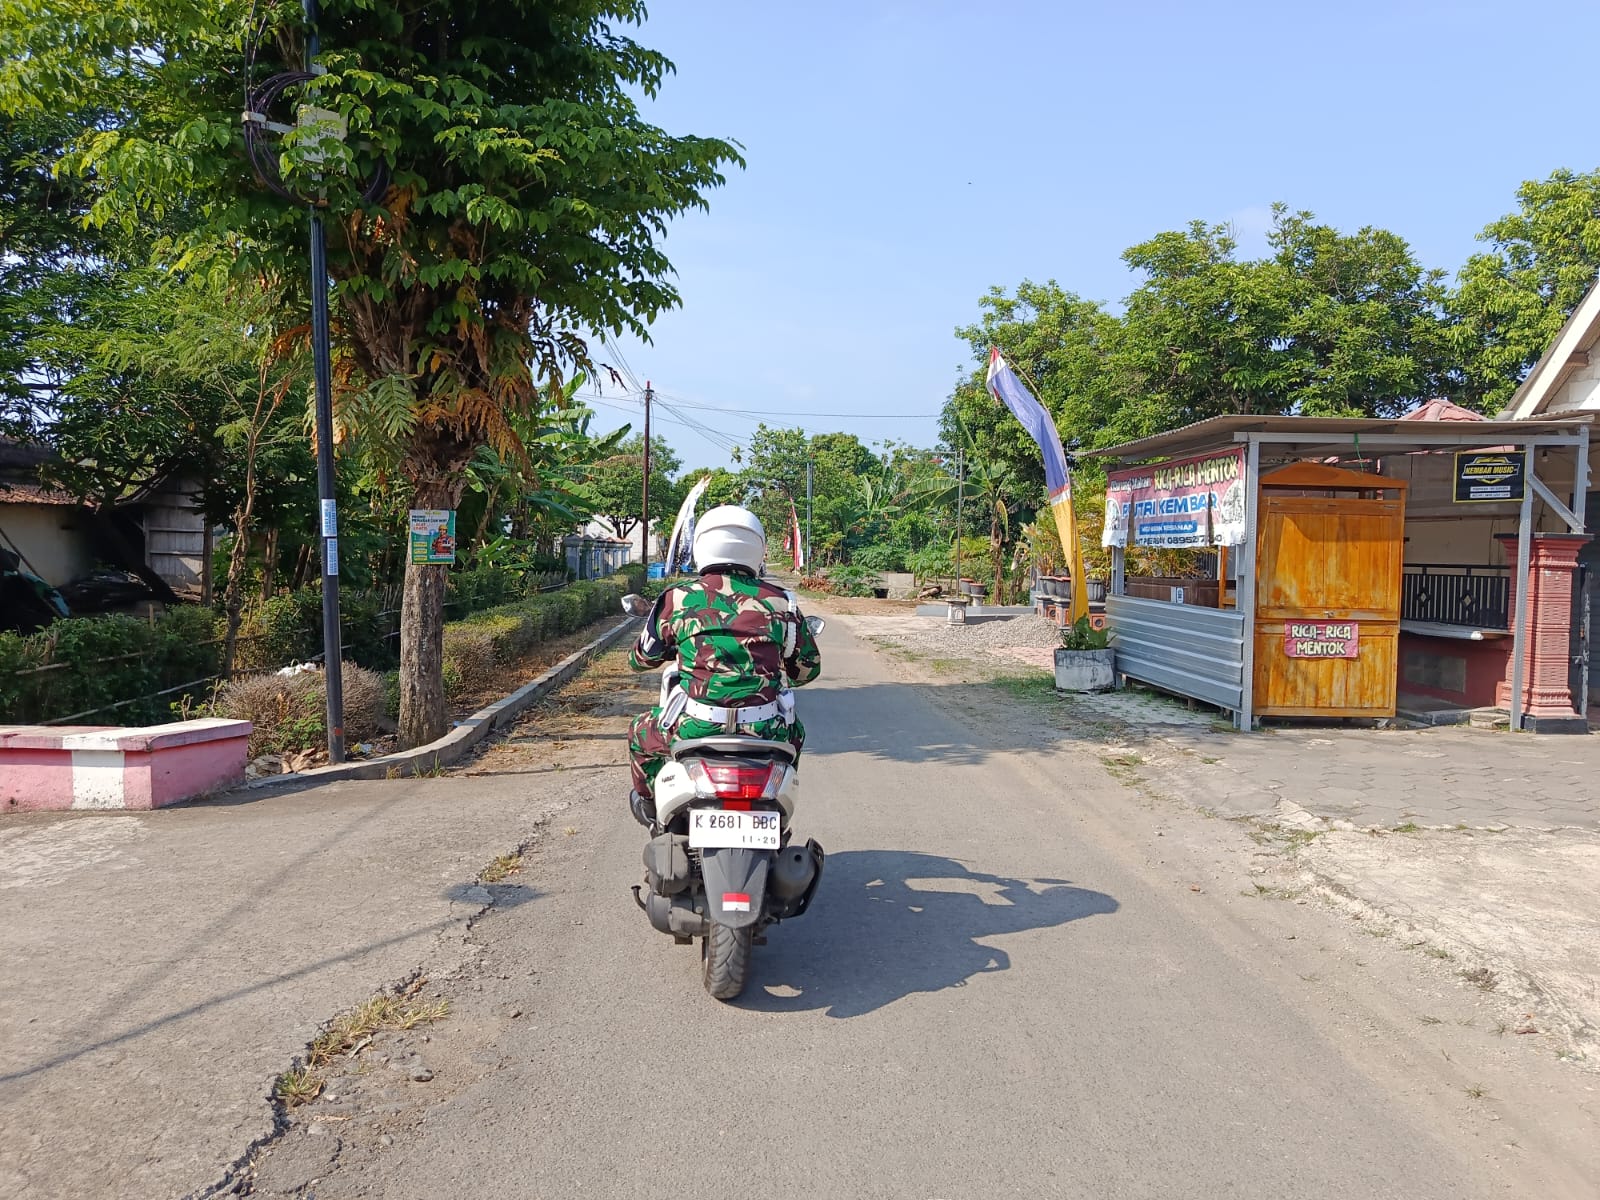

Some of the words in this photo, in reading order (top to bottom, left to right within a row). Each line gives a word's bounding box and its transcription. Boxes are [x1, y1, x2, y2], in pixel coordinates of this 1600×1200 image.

[1197, 456, 1238, 485] MENTOK
[1493, 466, 1514, 474] MUSIC
[1296, 641, 1346, 655] MENTOK
[695, 814, 704, 828] K
[709, 814, 742, 829] 2681
